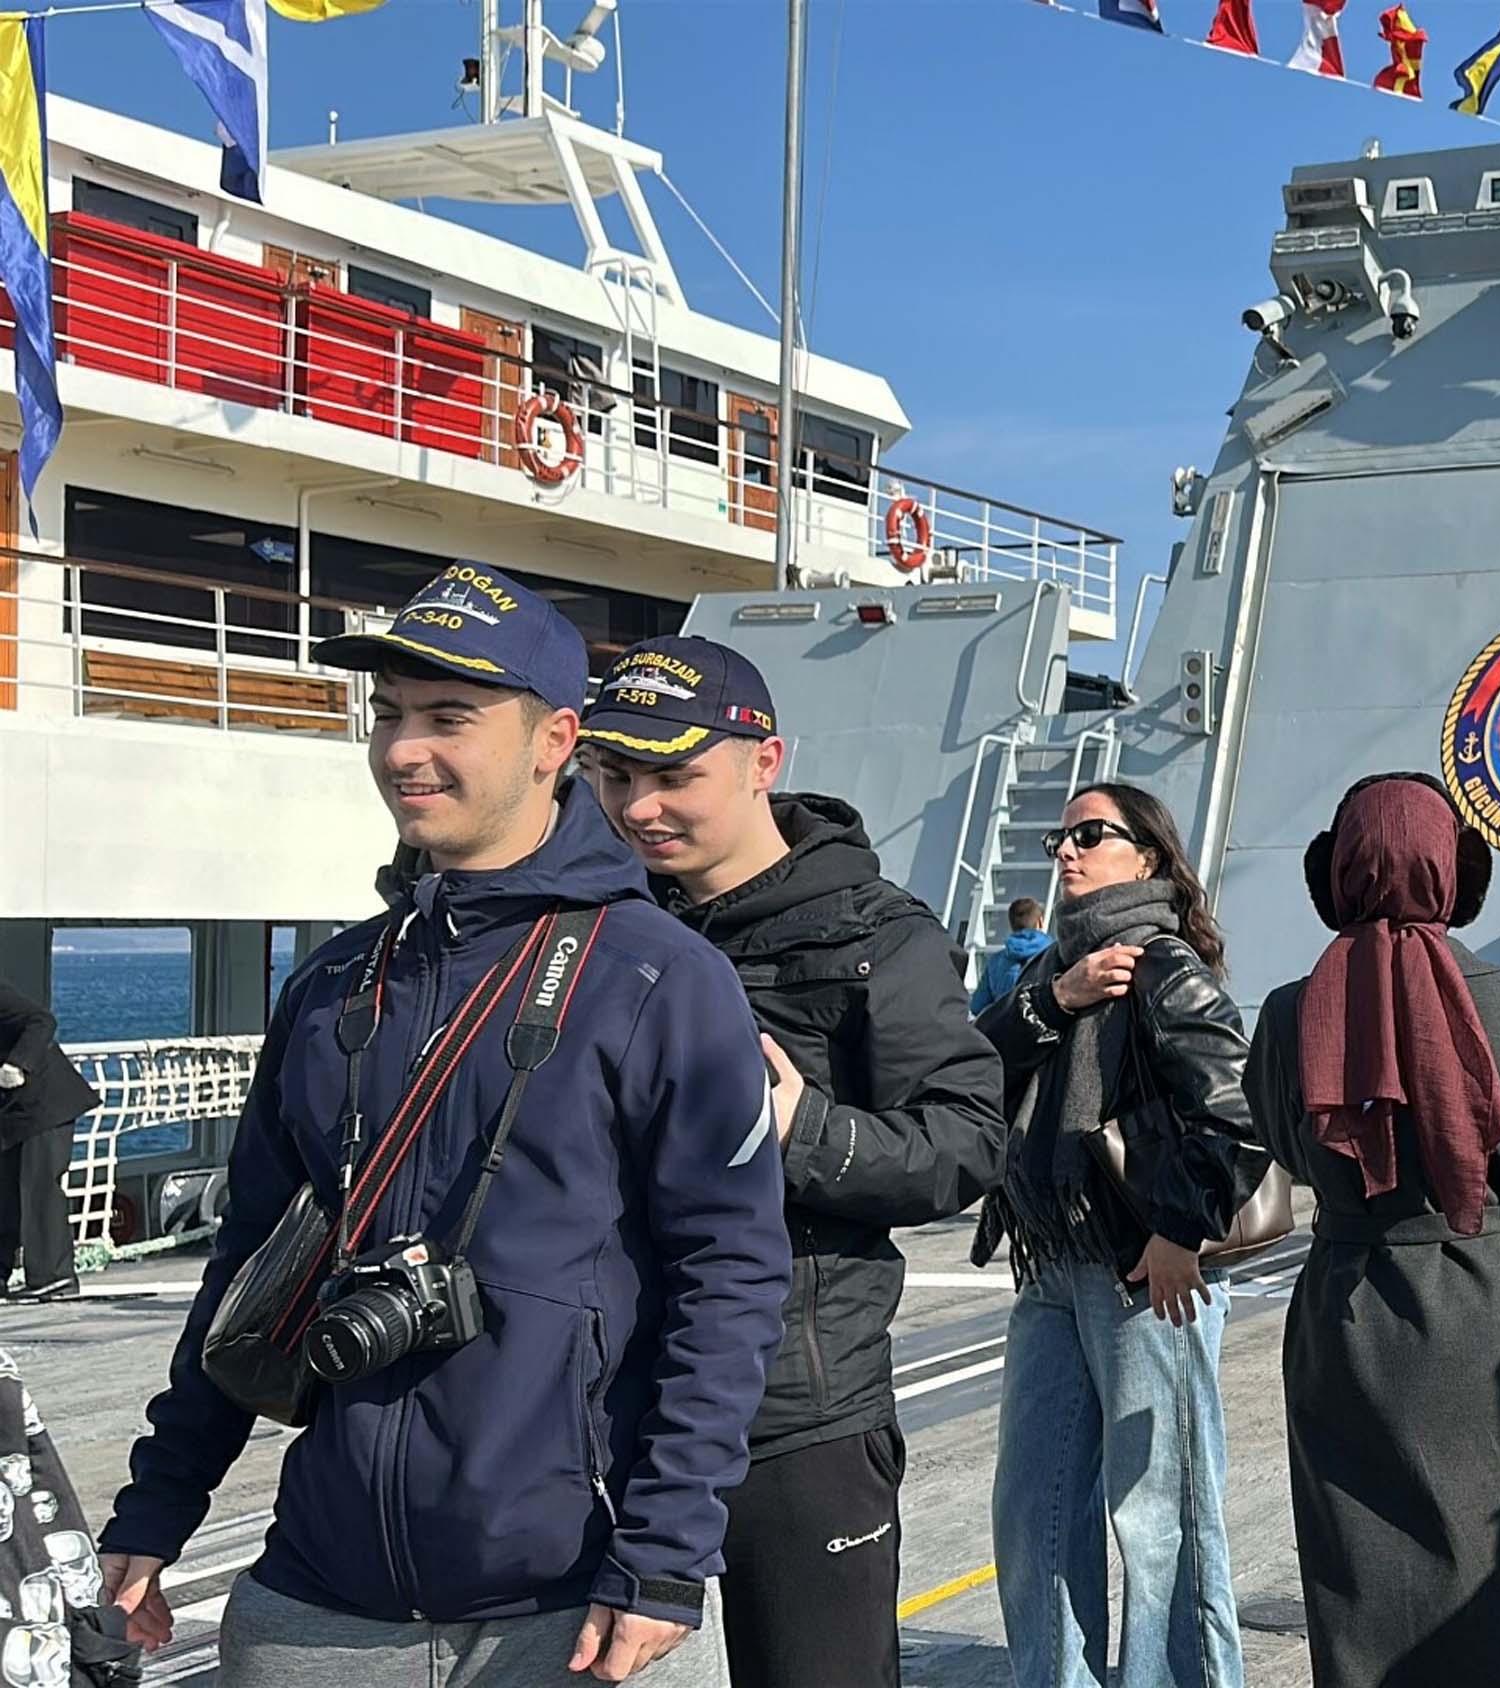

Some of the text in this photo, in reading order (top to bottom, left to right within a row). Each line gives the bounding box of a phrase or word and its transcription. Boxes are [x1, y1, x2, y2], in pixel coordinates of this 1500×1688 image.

[442, 565, 518, 612] DOĞAN
[630, 652, 703, 688] BURGAZADA
[616, 689, 657, 706] F-513
[535, 936, 578, 1007] Canon
